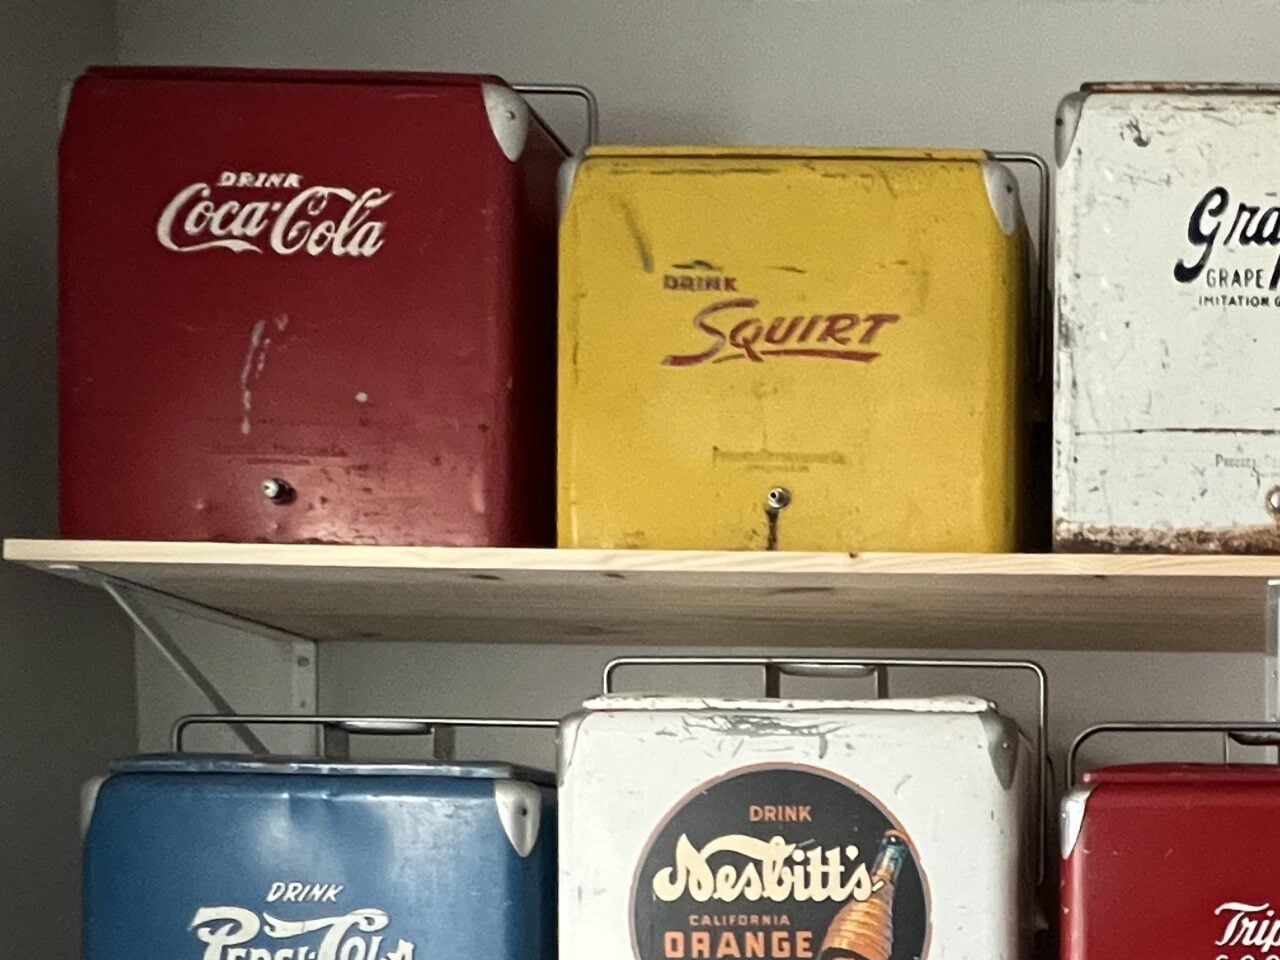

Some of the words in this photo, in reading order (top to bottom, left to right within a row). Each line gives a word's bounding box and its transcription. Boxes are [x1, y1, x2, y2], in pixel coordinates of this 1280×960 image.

[218, 171, 301, 188] DRINK
[156, 182, 394, 257] Coca-Cola
[662, 274, 738, 293] DRINK
[1206, 268, 1265, 290] GRAPE
[1199, 295, 1269, 307] IMITATION
[662, 298, 901, 367] SQUIRT
[749, 805, 812, 823] DRINK
[652, 833, 874, 902] Nesbitt's
[266, 882, 344, 903] DRINK
[688, 914, 791, 927] CALIFORNIA
[664, 931, 813, 959] ORANGE
